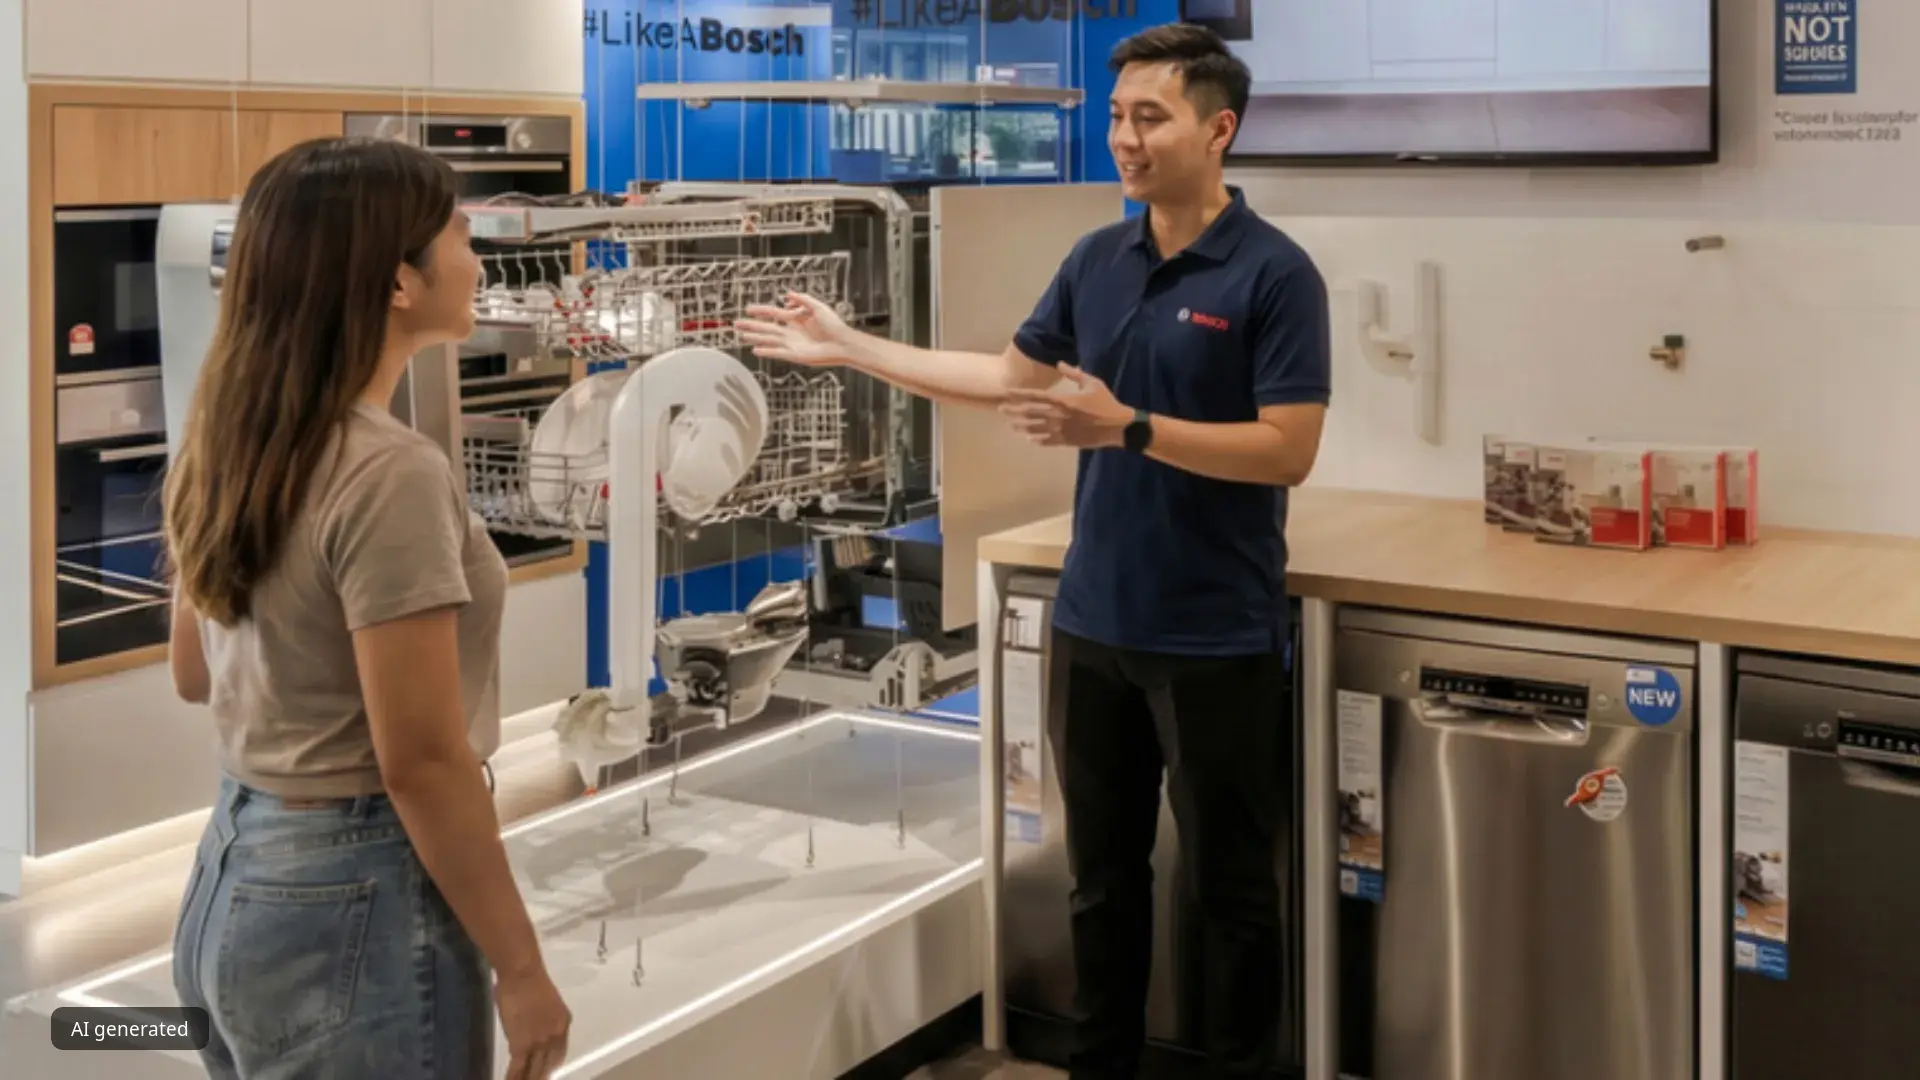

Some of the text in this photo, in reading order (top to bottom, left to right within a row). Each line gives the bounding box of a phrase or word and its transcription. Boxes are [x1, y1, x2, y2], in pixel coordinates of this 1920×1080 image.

[584, 9, 805, 57] #LikeABosch
[1784, 15, 1851, 43] NOT
[1628, 687, 1676, 708] NEW
